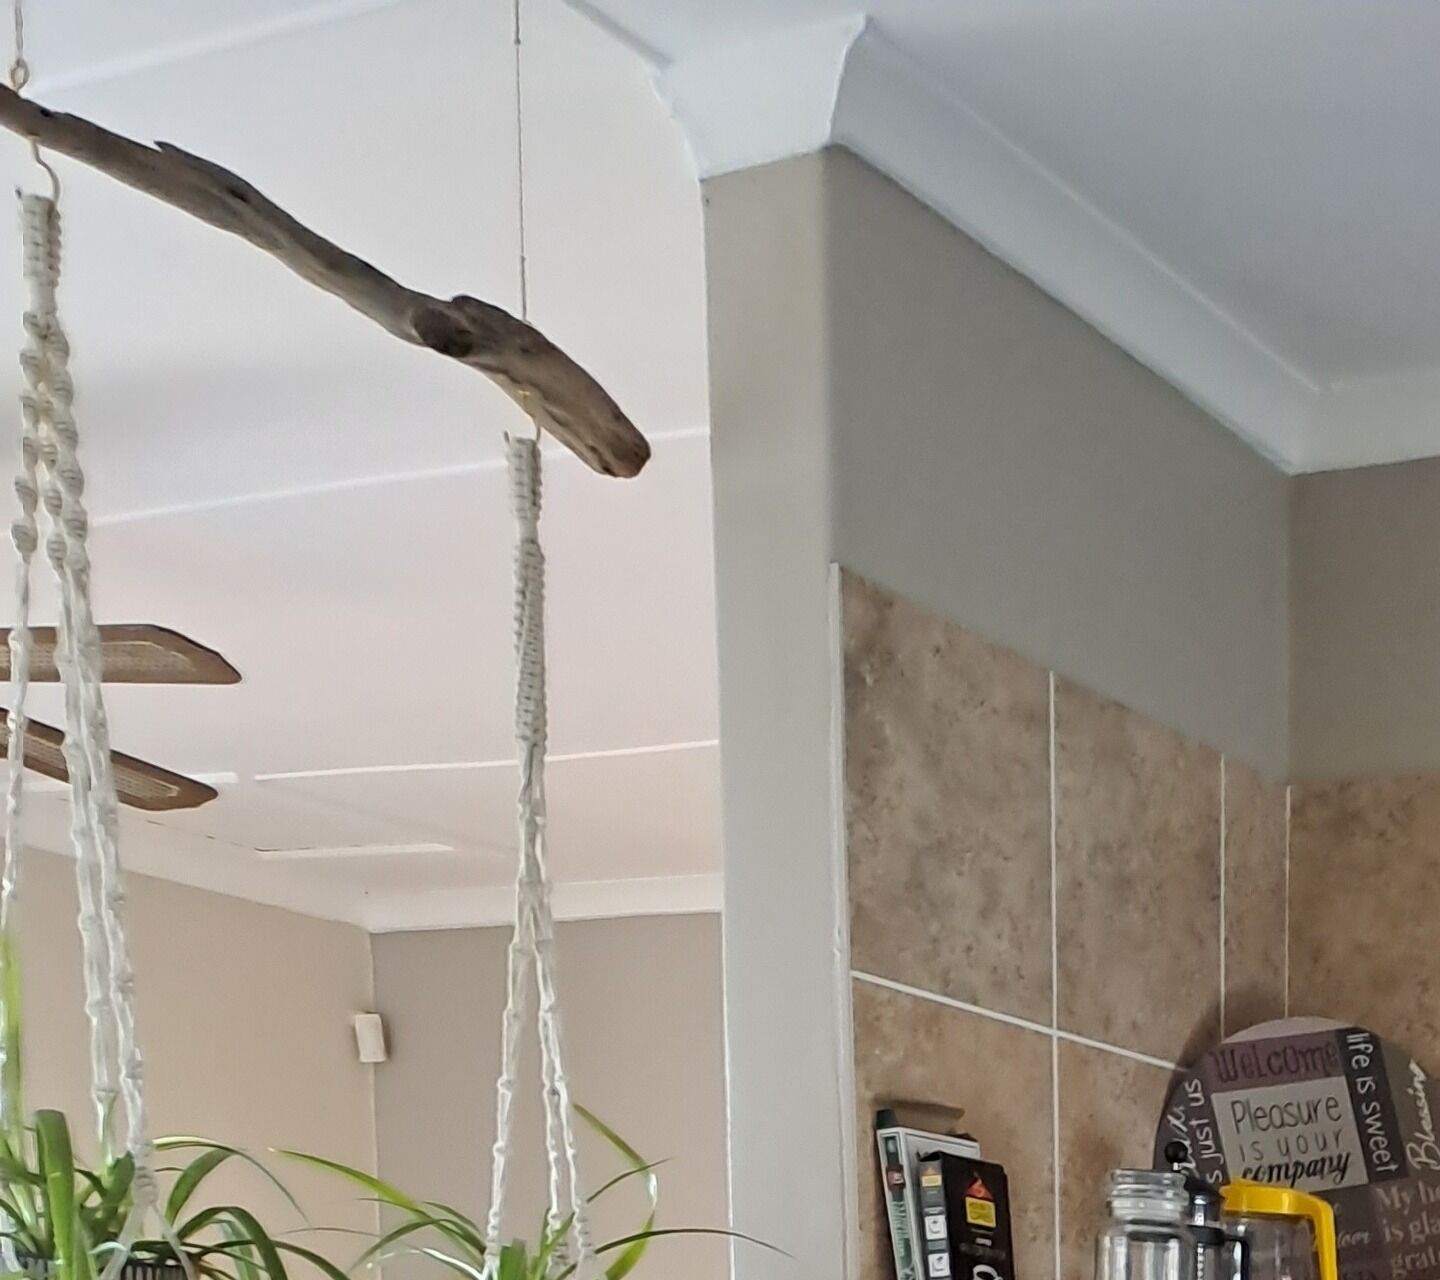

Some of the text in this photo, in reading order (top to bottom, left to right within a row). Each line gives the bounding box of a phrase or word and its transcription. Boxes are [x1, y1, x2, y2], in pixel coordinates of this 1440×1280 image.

[1231, 1096, 1342, 1134] Pleasure
[1346, 1033, 1373, 1069] life
[1362, 1101, 1399, 1173] sweet
[1277, 1128, 1342, 1162] your
[1242, 1152, 1351, 1188] company
[1375, 1183, 1411, 1215] My
[1382, 1218, 1404, 1243] is
